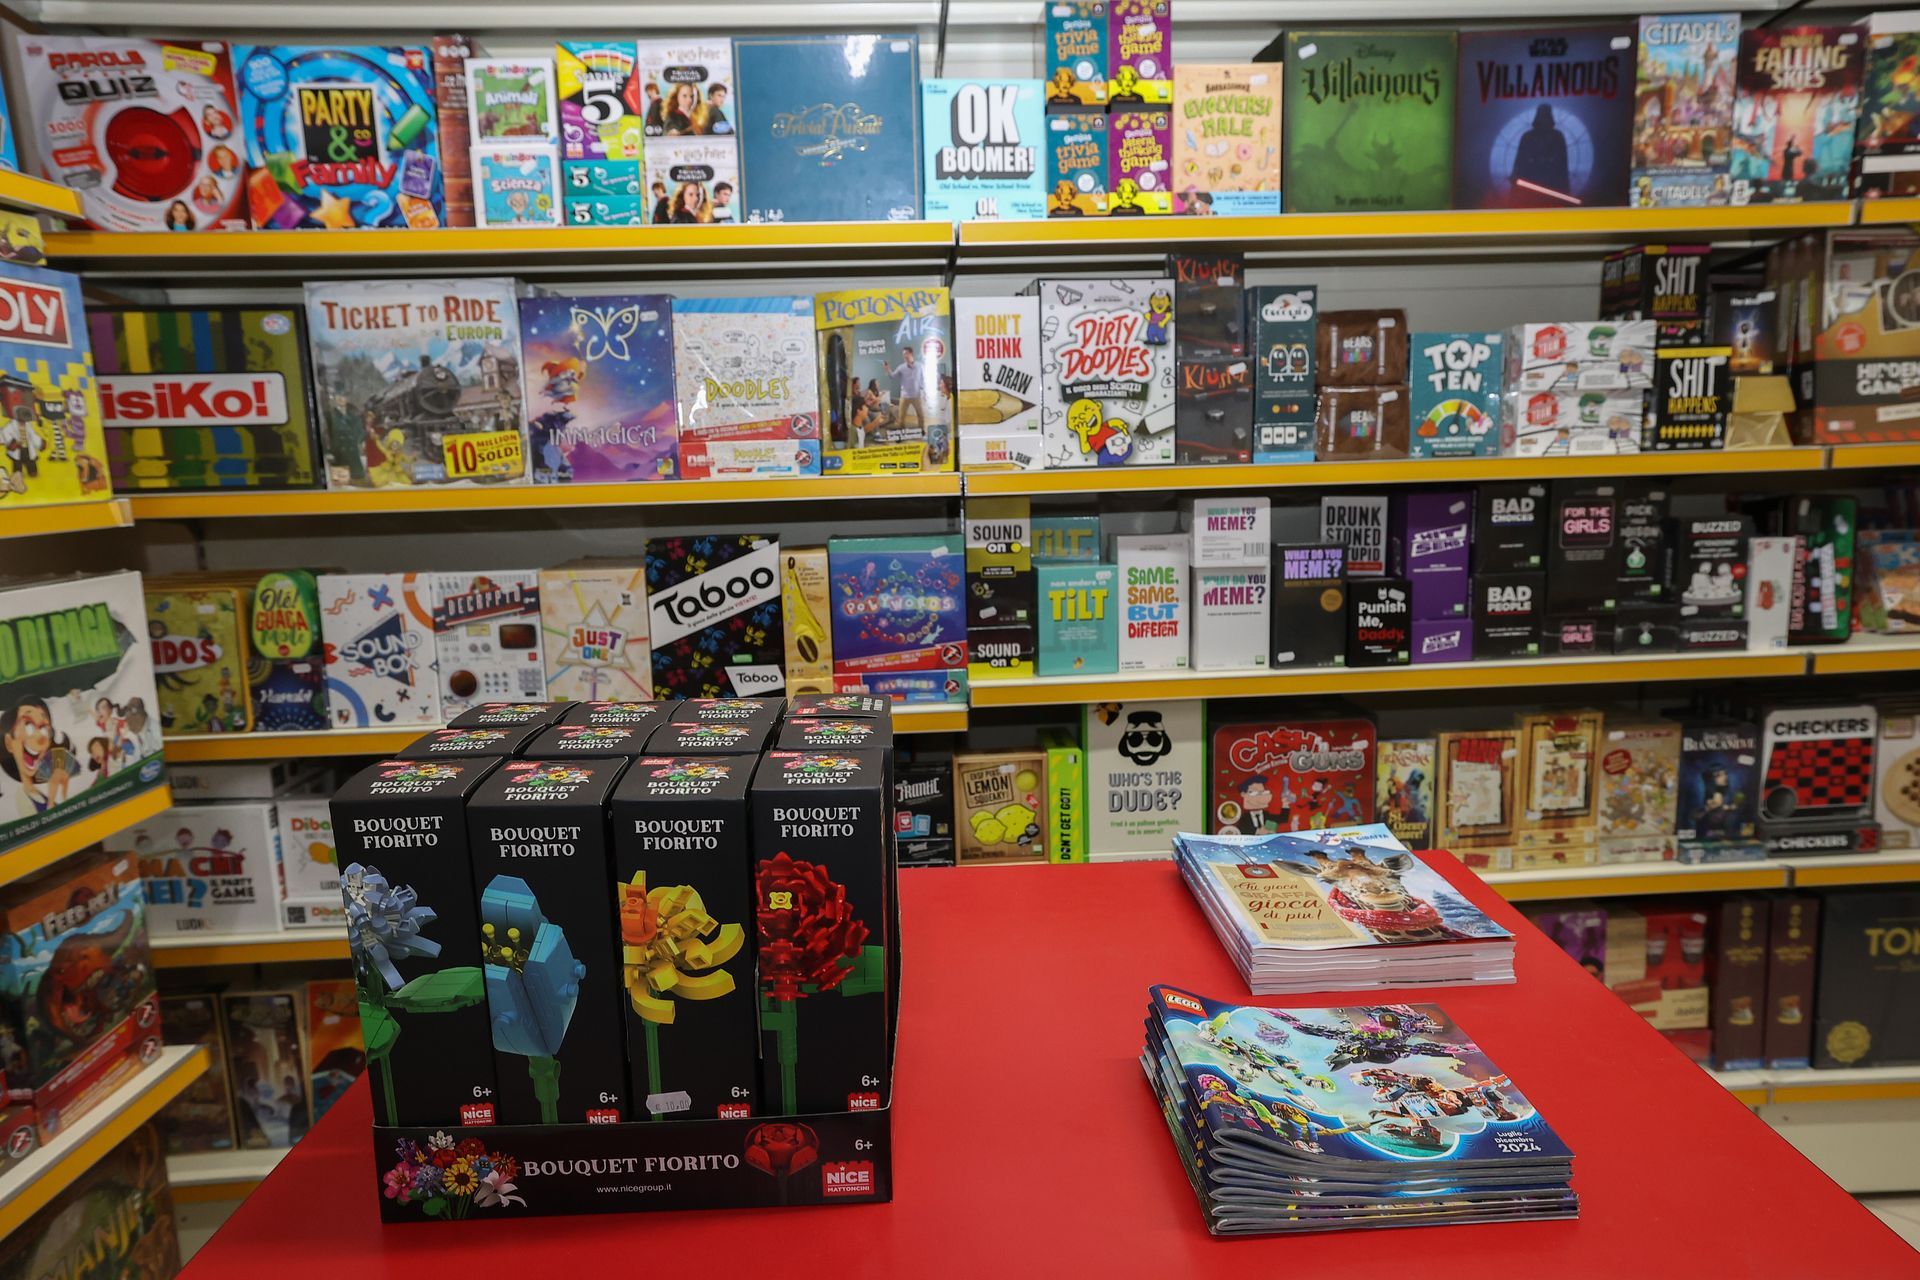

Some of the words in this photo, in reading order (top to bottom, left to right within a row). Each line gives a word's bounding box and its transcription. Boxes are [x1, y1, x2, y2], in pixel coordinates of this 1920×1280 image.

[1055, 28, 1099, 47] trivia
[1646, 20, 1736, 46] CITADELS
[1057, 43, 1100, 60] game
[1120, 42, 1163, 60] game
[1755, 46, 1847, 72] FALLING
[1302, 58, 1440, 106] Villainous
[1477, 56, 1619, 104] VILLAINOUS
[1770, 69, 1826, 90] SKIES
[58, 77, 158, 102] QUIZ
[485, 91, 537, 106] Animali
[581, 80, 624, 124] 5
[1184, 94, 1273, 119] EVOLVERSI
[300, 89, 373, 126] PARTY
[954, 83, 1020, 146] OK
[1202, 118, 1254, 138] MALE
[328, 127, 358, 162] &
[1056, 143, 1099, 160] trivia
[937, 146, 1036, 179] BOOMER!
[1057, 156, 1100, 174] game
[289, 157, 397, 188] Family
[572, 168, 590, 188] 5
[490, 178, 542, 193] Scienza
[572, 202, 592, 223] 5
[1654, 256, 1701, 296] SHIT
[821, 289, 942, 323] PICTIONARY
[1652, 295, 1698, 313] HAPPENS
[320, 300, 412, 332] TICKET
[418, 303, 438, 323] TO
[443, 295, 503, 325] RIDE
[446, 325, 503, 341] EUROPA
[895, 313, 945, 345] AIR
[975, 314, 1021, 336] DON'T
[1075, 313, 1138, 349] DIRTY
[975, 337, 1022, 359] DRINK
[1424, 339, 1491, 373] TOP
[1060, 346, 1150, 380] DOODLES
[983, 362, 992, 382] &
[995, 364, 1033, 395] DRAW
[1428, 370, 1482, 393] TEN
[1668, 357, 1720, 399] SHIT
[703, 376, 791, 402] DOODLES
[1667, 396, 1720, 414] HAPPENS
[549, 424, 657, 447] IMMAGICA
[446, 440, 479, 475] 10
[476, 432, 518, 449] MILLION
[985, 440, 1007, 451] DON'T
[476, 446, 521, 464] SOLD!
[985, 451, 1007, 461] DRINK
[1492, 498, 1535, 513] BAD
[1565, 507, 1586, 518] FOR
[1588, 506, 1611, 517] THE
[1207, 516, 1256, 531] MEME?
[1326, 505, 1382, 526] DRUNK
[1492, 513, 1535, 523] CHOICES
[973, 525, 1023, 541] SOUND
[1564, 518, 1611, 534] GIRLS
[1691, 521, 1742, 534] BUZZED
[1326, 527, 1382, 546] STONED
[987, 543, 1008, 553] on
[1284, 550, 1310, 560] WHAT
[1311, 549, 1323, 560] DO
[1324, 548, 1342, 559] YOU
[1284, 559, 1342, 579] MEME?
[1248, 574, 1266, 585] YOU
[261, 588, 298, 611] Olé!
[447, 583, 523, 617] DECRYPTO
[653, 566, 775, 625] Taboo
[1203, 585, 1266, 606] MEME?
[1487, 586, 1532, 602] BAD
[844, 595, 957, 615] POLYWORDS
[1127, 604, 1179, 621] BUT
[1358, 600, 1406, 614] Punish
[1487, 601, 1532, 612] PEOPLE
[256, 609, 308, 632] GUACA
[1358, 616, 1383, 629] Me,
[17, 612, 47, 671] DI
[51, 602, 121, 665] PAGA
[572, 627, 622, 650] JUST
[1562, 632, 1593, 643] GIRLS
[1690, 630, 1739, 642] BUZZED
[343, 630, 422, 662] SOUND
[582, 644, 609, 661] ONE
[977, 643, 1021, 659] SOUND
[373, 654, 420, 678] BOX
[990, 658, 1008, 667] on
[735, 672, 779, 684] Taboo
[1774, 718, 1871, 737] CHECKERS
[1230, 727, 1316, 771] CASH
[1289, 750, 1366, 772] GUNS
[783, 771, 854, 779] BOUQUET
[787, 777, 848, 785] FIORITO
[1108, 771, 1154, 787] WHO'S
[1155, 771, 1182, 786] THE
[370, 780, 446, 789] BOUQUET
[370, 786, 434, 795] FIORITO
[504, 785, 579, 795] BOUQUET
[647, 780, 721, 789] BOUQUET
[650, 787, 713, 795] FIORITO
[967, 775, 1009, 796] LEMON
[505, 792, 570, 801] FIORITO
[1060, 787, 1071, 812] GOT!
[1108, 788, 1182, 812] DUDE?
[773, 806, 861, 823] BOUQUET
[1060, 813, 1071, 829] GET
[354, 816, 443, 834] BOUQUET
[635, 819, 724, 835] BOUQUET
[781, 823, 854, 838] FIORITO
[363, 833, 438, 849] FIORITO
[490, 826, 581, 843] BOUQUET
[1778, 836, 1848, 849] CHECKERS
[500, 843, 576, 858] FIORITO
[643, 836, 718, 851] FIORITO
[1060, 830, 1071, 860] DON'T
[212, 886, 255, 898] GAME
[1263, 884, 1298, 892] gioca
[1248, 900, 1322, 912] gioca
[1167, 993, 1203, 1011] LEGO
[861, 1075, 880, 1086] 6+
[472, 1086, 492, 1098] 6+
[599, 1092, 618, 1103] 6+
[731, 1086, 750, 1098] 6+
[850, 1095, 878, 1108] NICE
[463, 1105, 492, 1120] NICE
[589, 1111, 617, 1124] NICE
[720, 1106, 748, 1119] NICE
[1496, 1130, 1523, 1139] Luglio
[854, 1139, 874, 1150] 6+
[1498, 1143, 1542, 1154] 2024
[524, 1157, 639, 1178] BOUQUET
[645, 1154, 740, 1173] FIORITO
[826, 1165, 870, 1184] NICE
[596, 1183, 673, 1194] www.nicegroup.it
